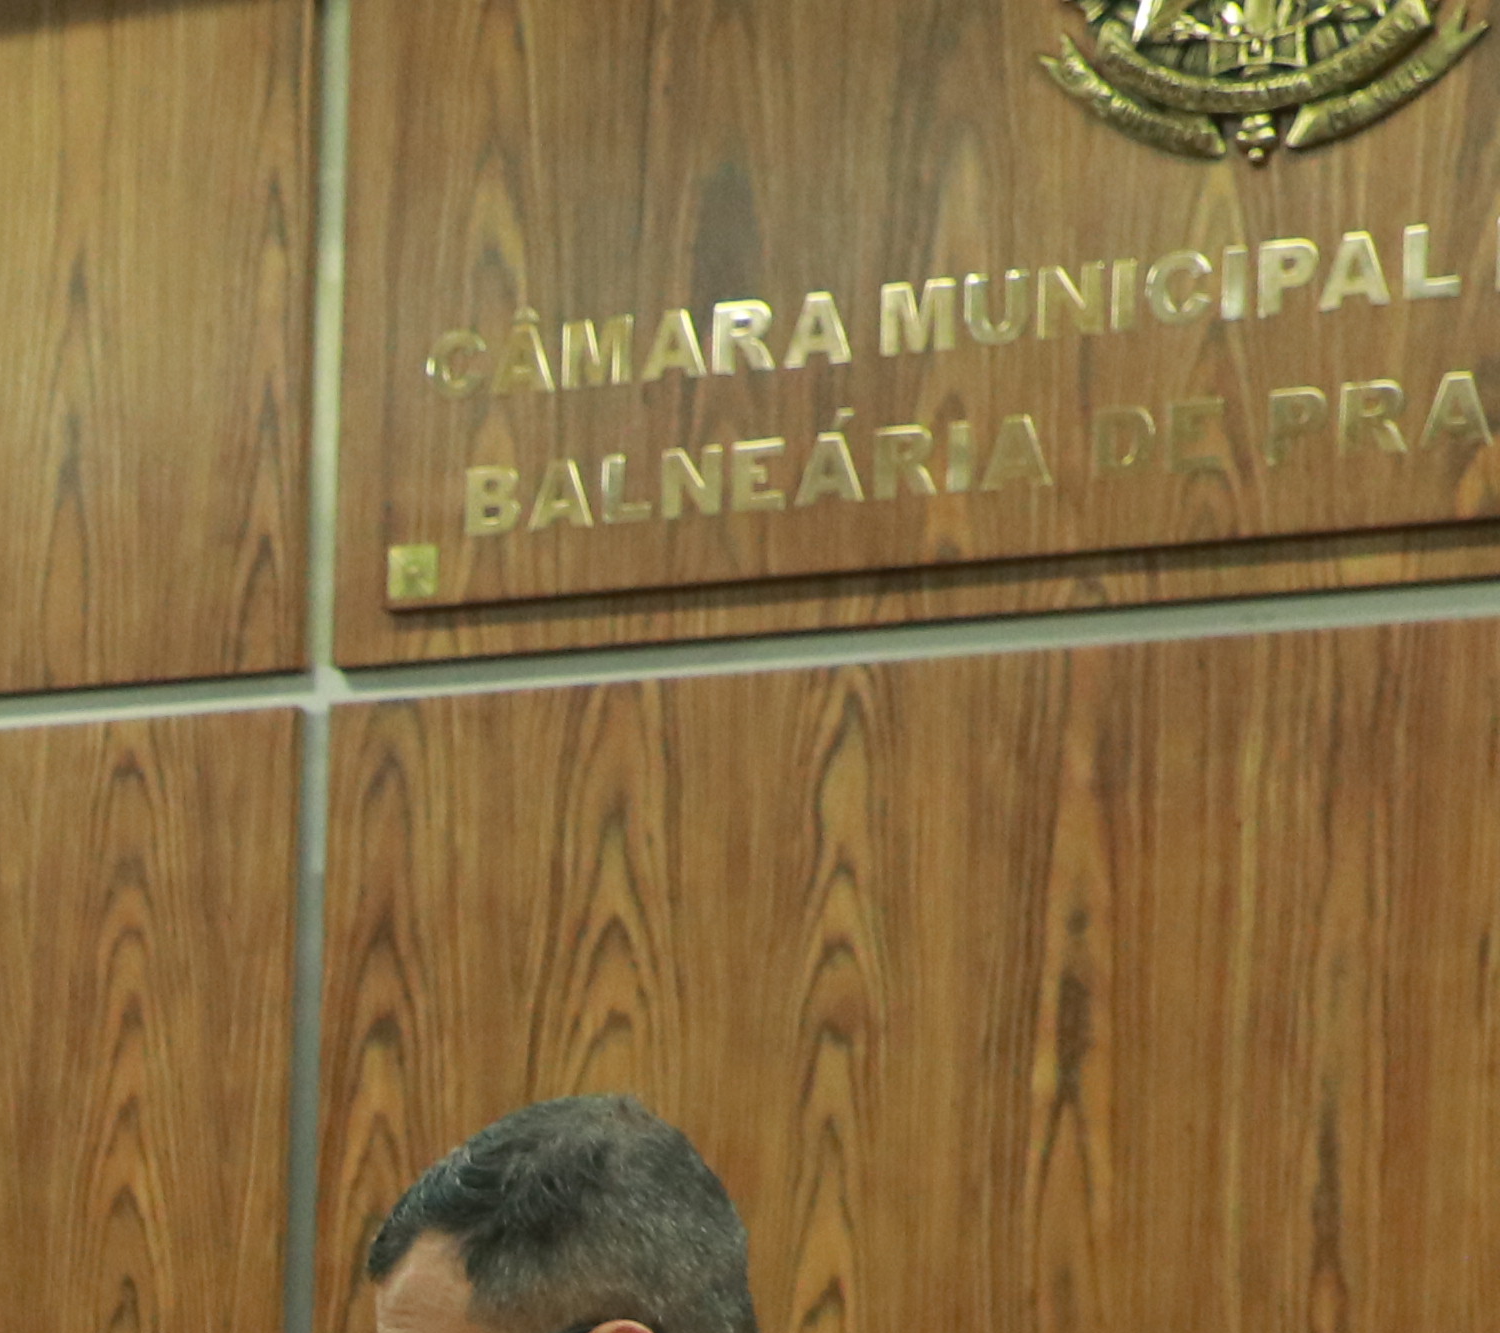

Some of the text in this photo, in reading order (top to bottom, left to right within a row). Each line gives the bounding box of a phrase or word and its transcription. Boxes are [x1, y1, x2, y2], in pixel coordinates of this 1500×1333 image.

[425, 222, 1461, 398] CÂMARA MUNICIPAL
[463, 405, 1055, 537] BALNEÁRIA
[1092, 394, 1226, 478] DE
